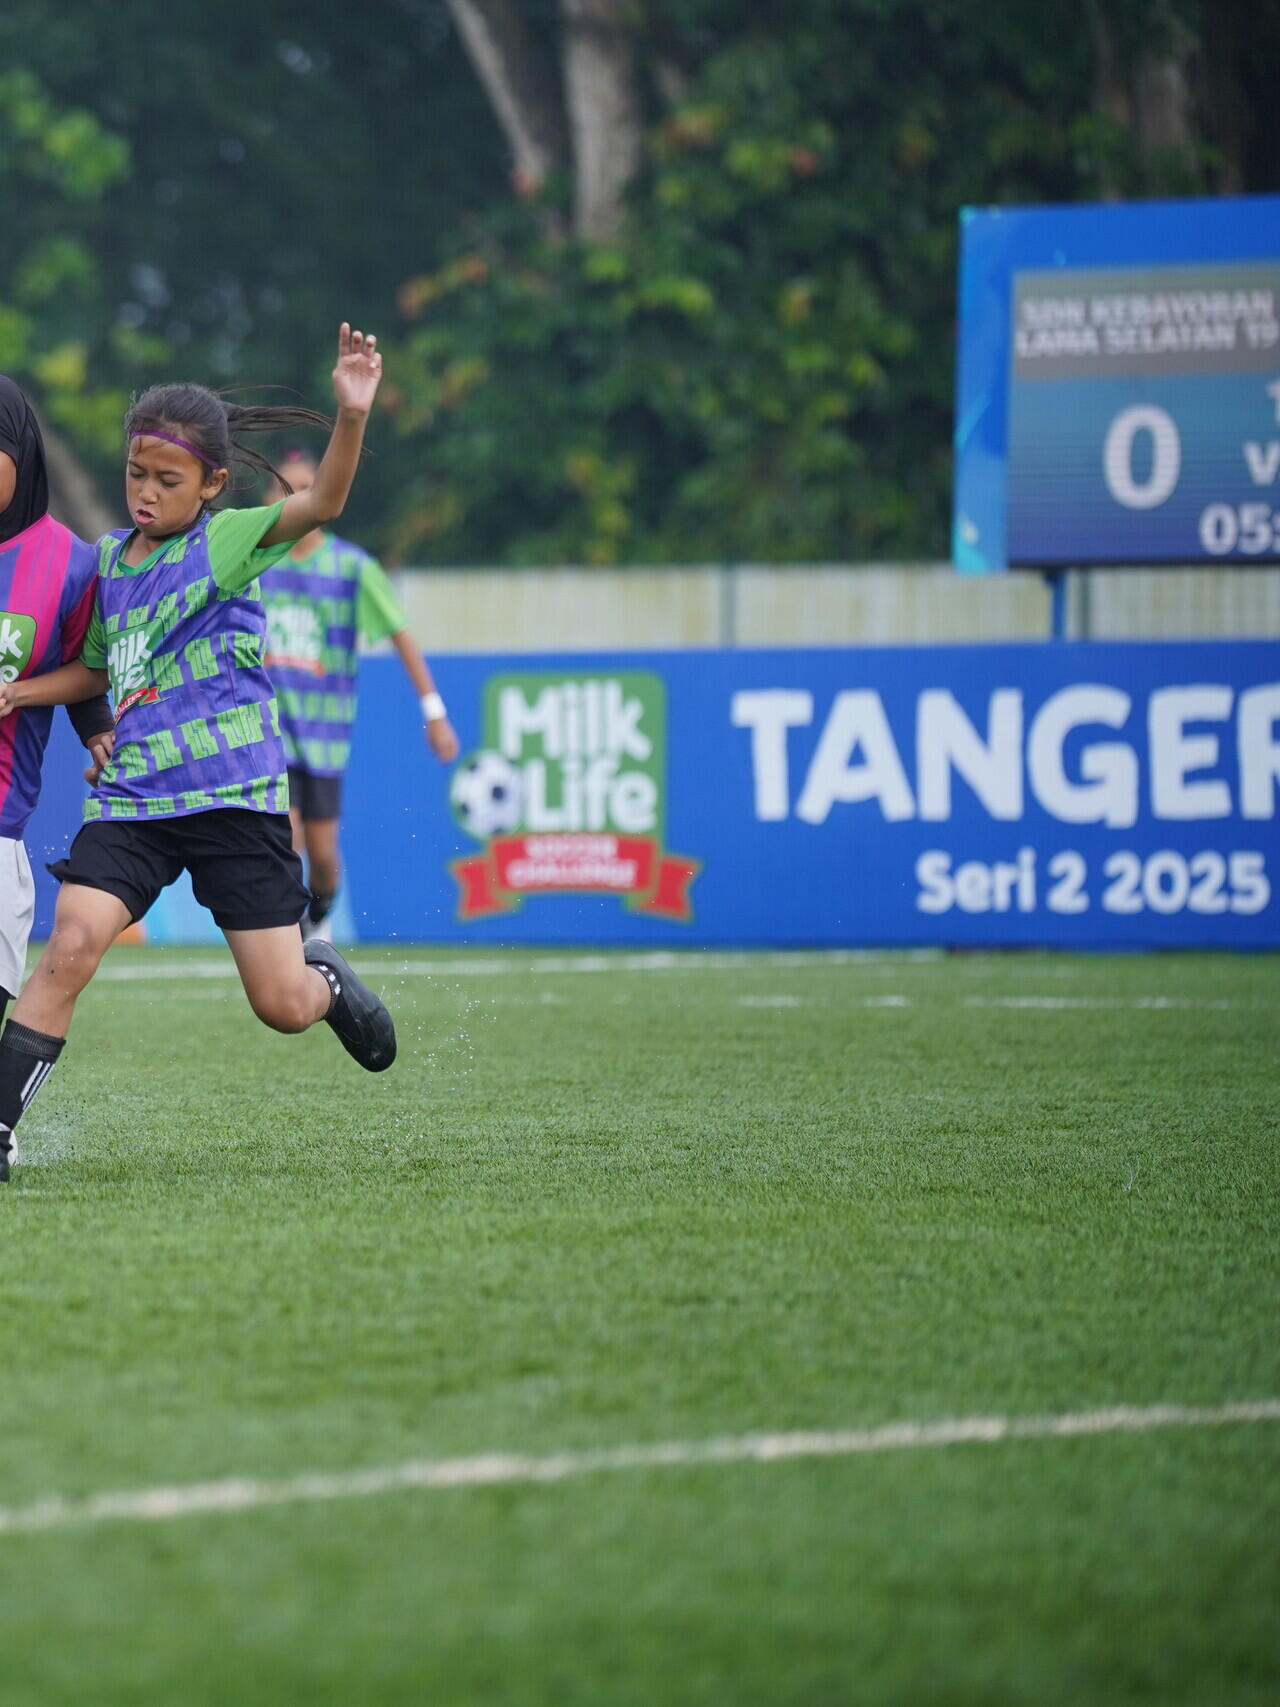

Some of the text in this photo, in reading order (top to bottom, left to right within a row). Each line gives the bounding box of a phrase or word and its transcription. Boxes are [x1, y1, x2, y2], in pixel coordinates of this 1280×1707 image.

[1103, 403, 1181, 510] 0
[499, 680, 653, 762] Milk
[521, 757, 658, 832] Life
[915, 847, 1270, 915] Seri 2 2025
